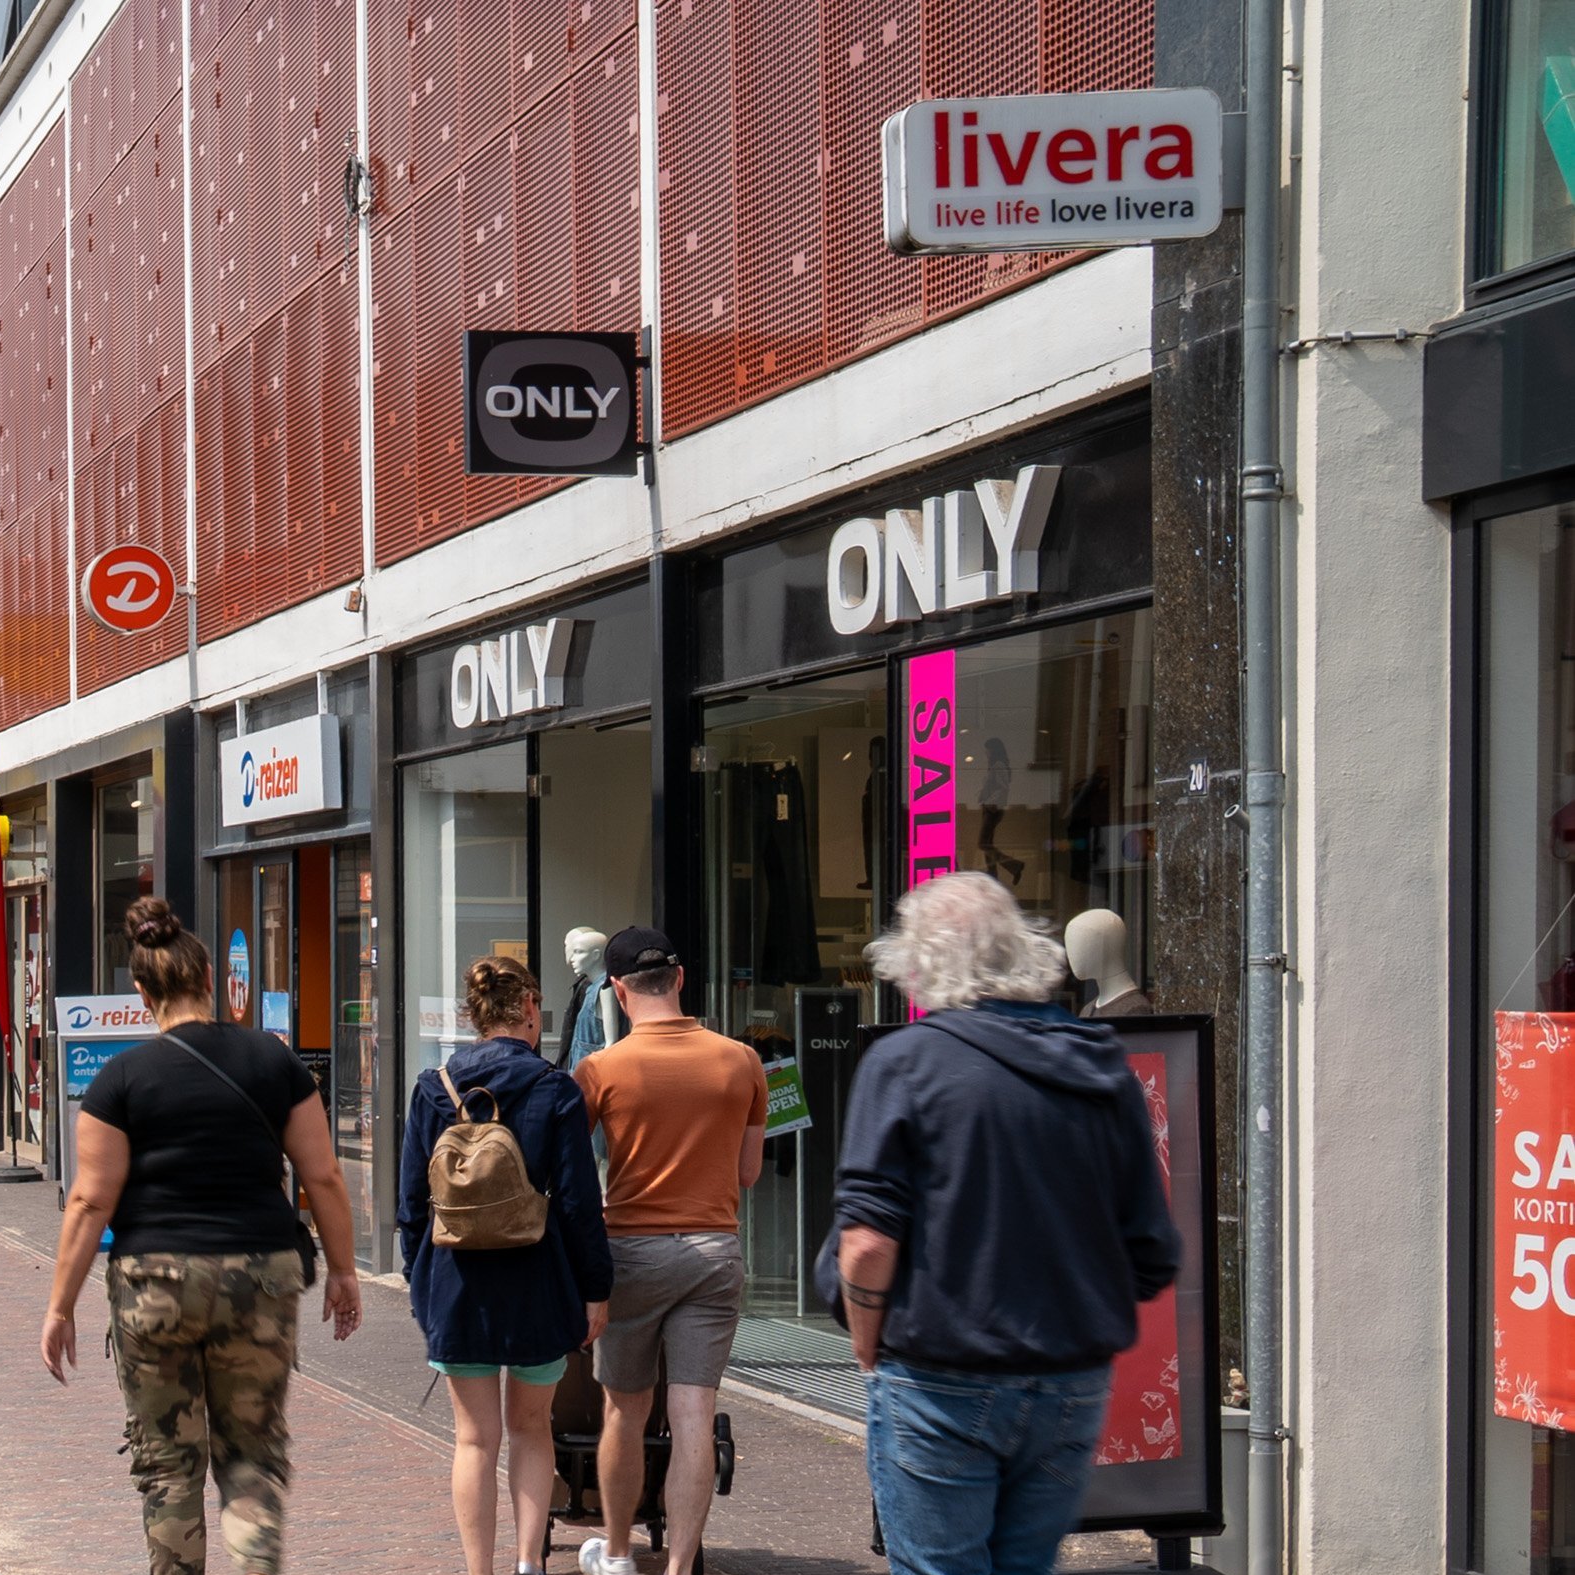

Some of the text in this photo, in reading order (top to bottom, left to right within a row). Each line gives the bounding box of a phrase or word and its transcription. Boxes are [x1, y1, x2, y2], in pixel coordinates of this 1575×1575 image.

[933, 111, 1194, 189] livera
[936, 194, 1195, 228] live life love livera
[483, 385, 622, 420] ONLY
[828, 465, 1062, 635] ONLY
[452, 617, 577, 729] ONLY
[241, 747, 299, 807] D-reizen
[1190, 763, 1203, 791] 20
[67, 1005, 152, 1029] D-reize
[810, 1038, 851, 1049] ONLY
[770, 1083, 798, 1100] NDAG
